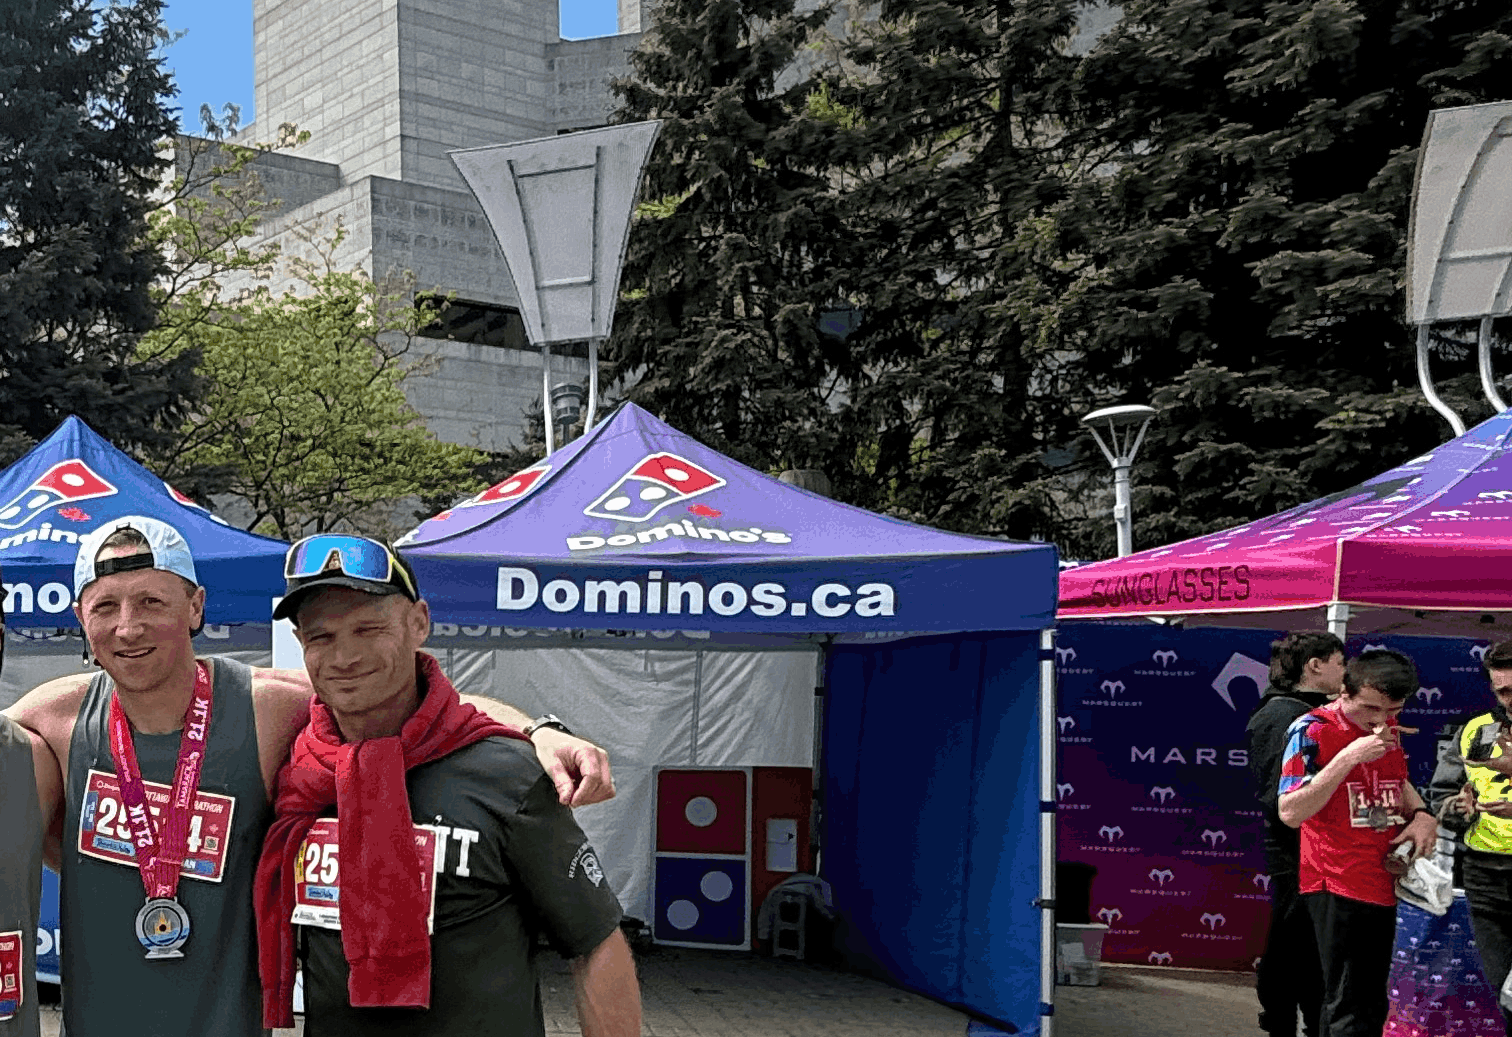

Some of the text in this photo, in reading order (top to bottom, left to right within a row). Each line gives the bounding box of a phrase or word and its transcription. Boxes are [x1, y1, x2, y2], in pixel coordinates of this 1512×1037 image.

[566, 519, 792, 550] Domino's
[496, 567, 895, 616] Dominos.ca
[1090, 564, 1251, 608] SUNGLASSES
[187, 696, 209, 741] 21.1K
[1130, 745, 1249, 767] MARS
[128, 803, 154, 848] 21.1K
[305, 843, 339, 884] 25
